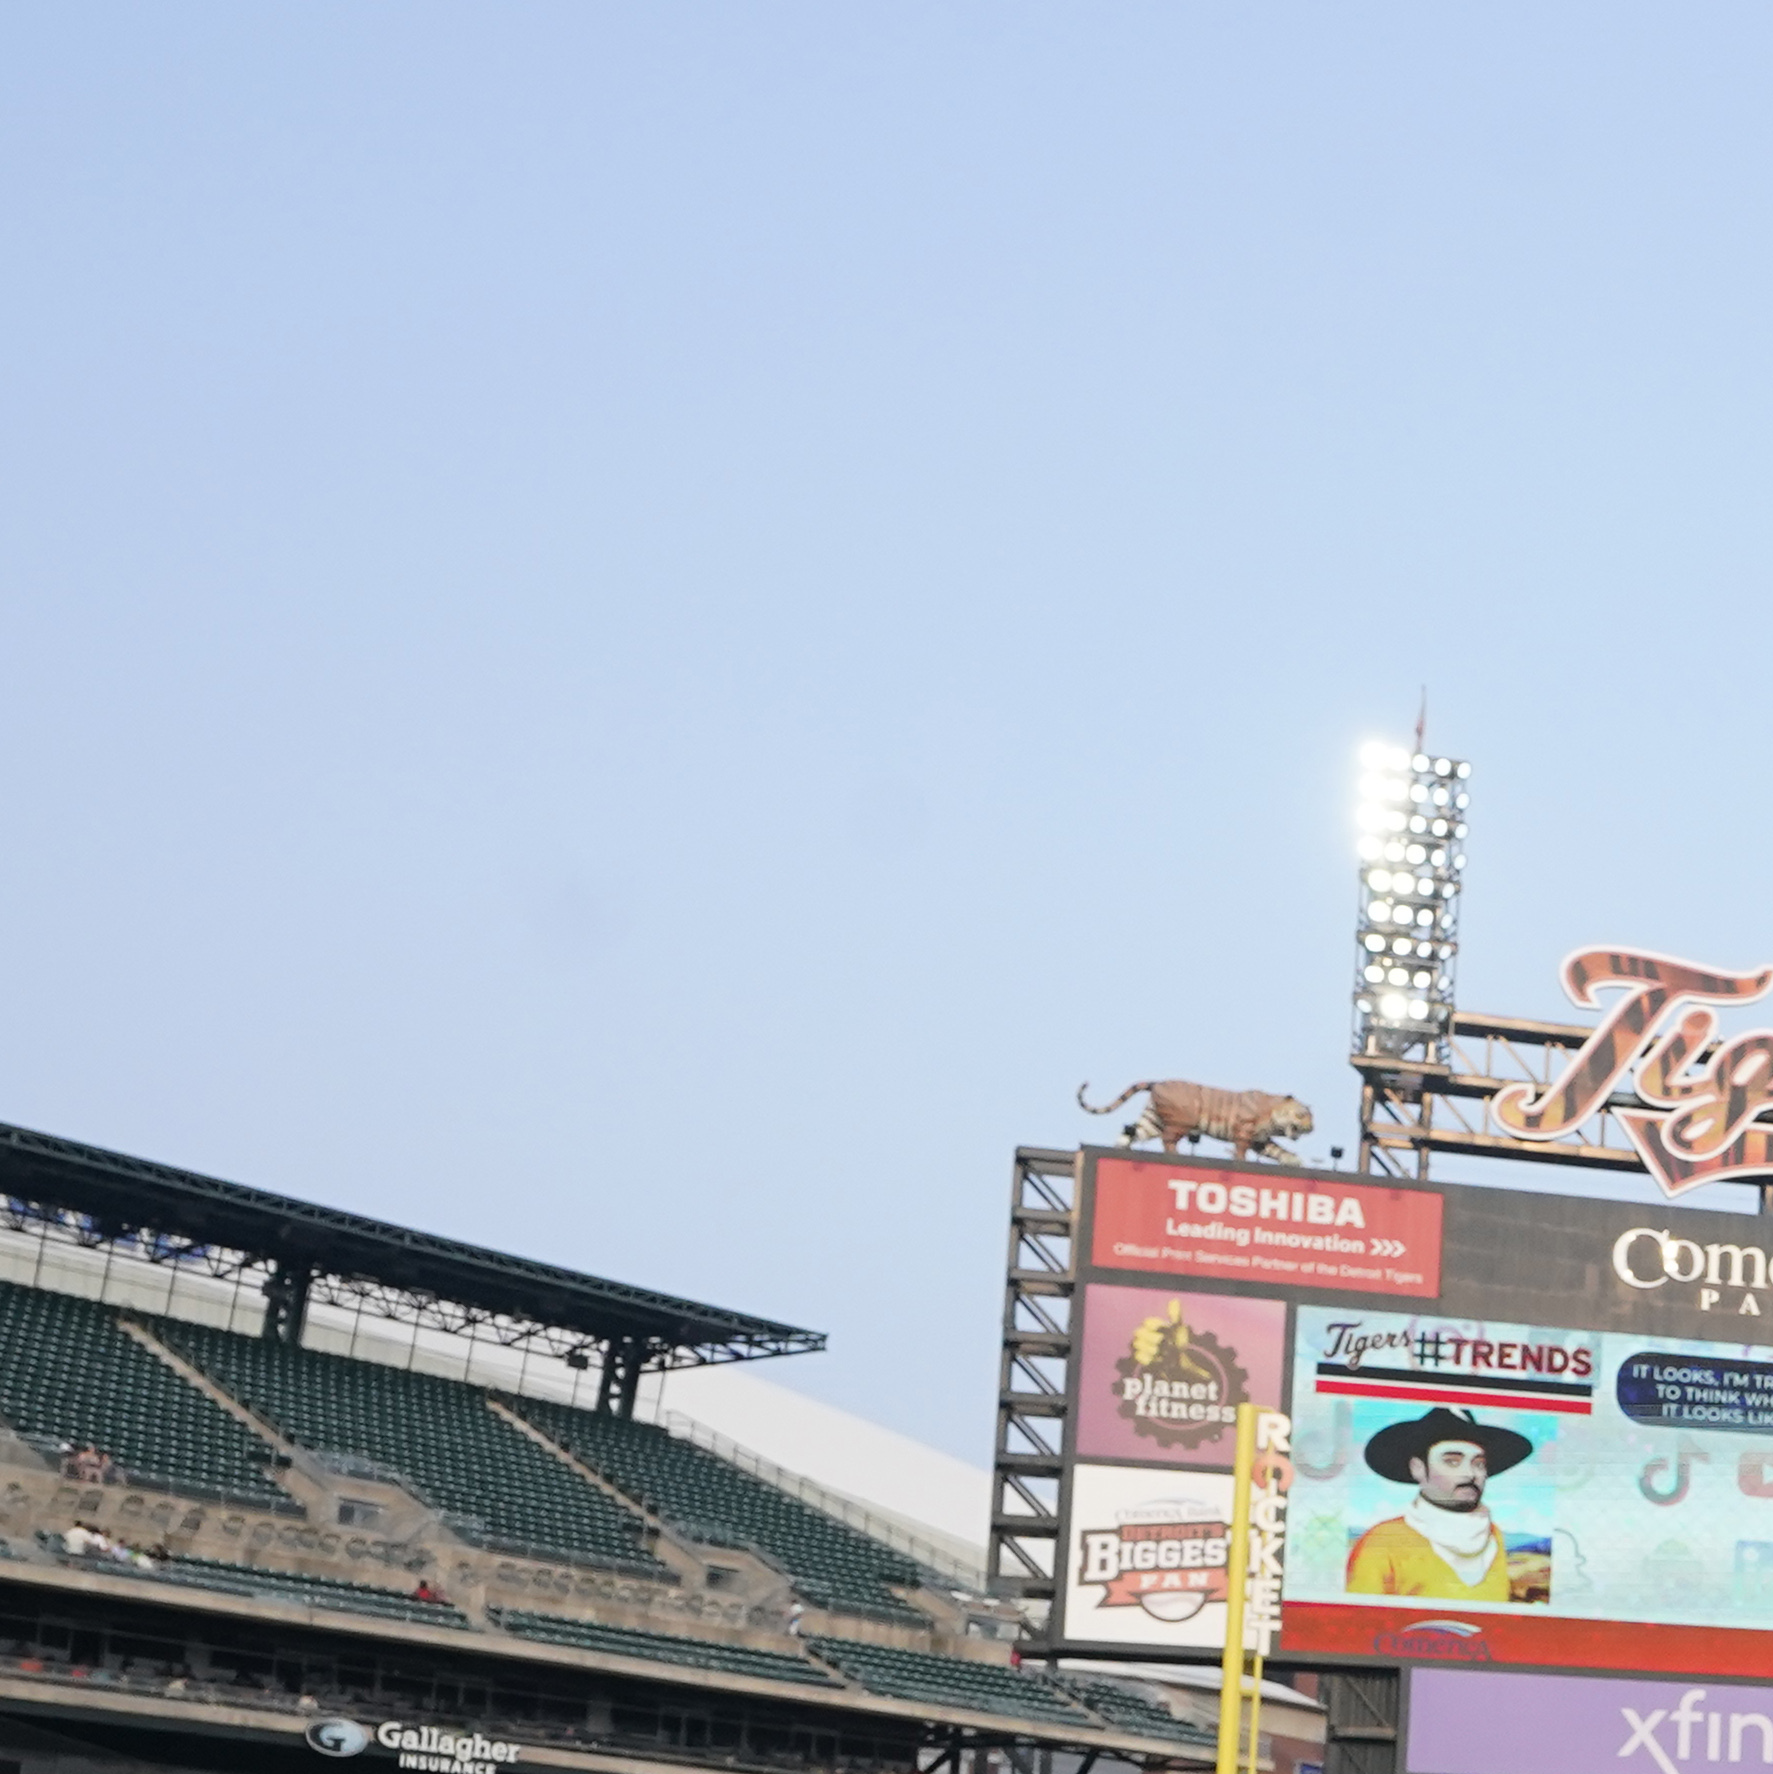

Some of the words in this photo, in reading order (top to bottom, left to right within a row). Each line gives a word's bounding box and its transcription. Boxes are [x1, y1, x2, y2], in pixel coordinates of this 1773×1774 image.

[1168, 1179, 1366, 1229] TOSHIBA
[1166, 1218, 1250, 1246] Leading
[1254, 1227, 1365, 1254] Innovation
[1324, 1322, 1411, 1367] Tigers
[1414, 1331, 1592, 1375] #TRENDS
[1632, 1364, 1649, 1379] IT
[1122, 1373, 1218, 1401] planet
[1656, 1383, 1681, 1401] TO
[1685, 1386, 1740, 1405] THINK
[1135, 1396, 1236, 1423] fitness
[1662, 1403, 1678, 1418] IT
[1682, 1404, 1744, 1423] LOOKS
[1139, 1573, 1208, 1589] FAN
[377, 1721, 520, 1764] Gallagher
